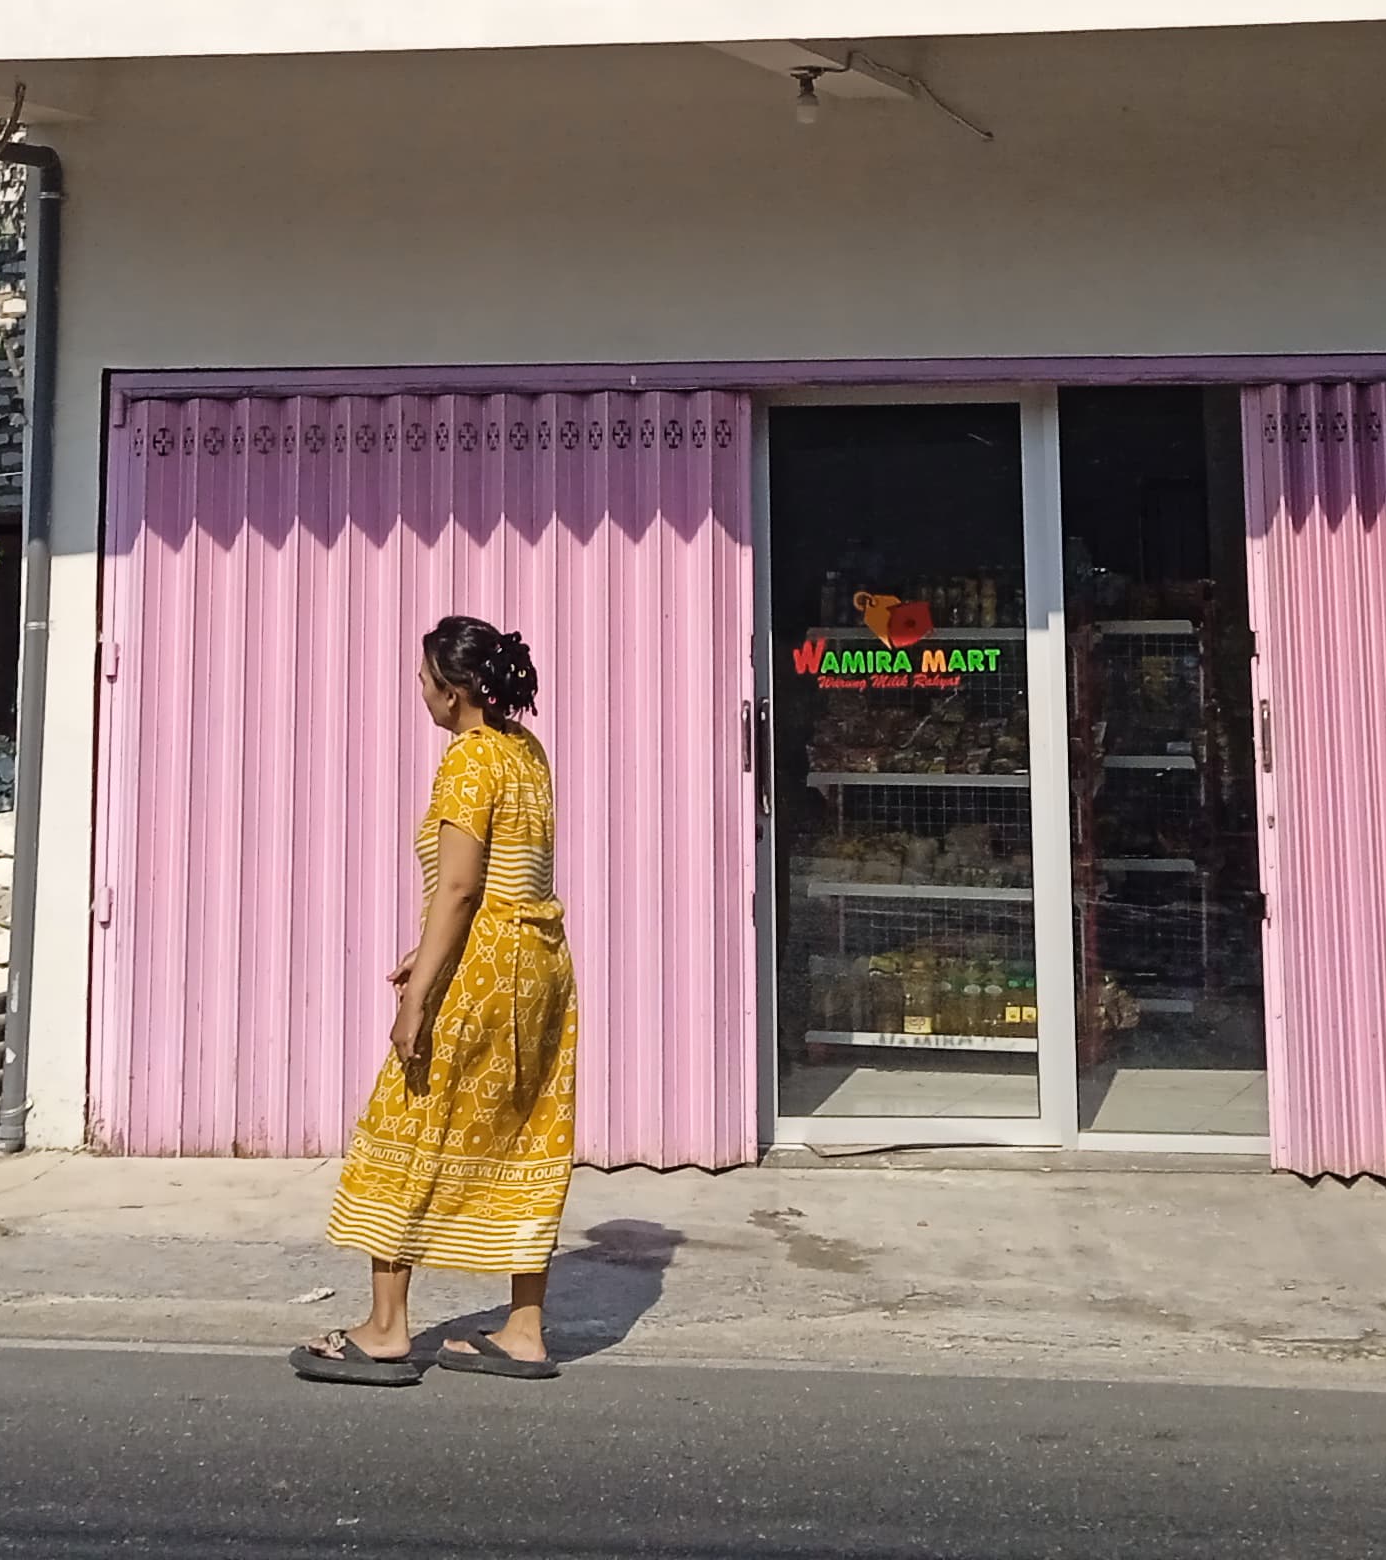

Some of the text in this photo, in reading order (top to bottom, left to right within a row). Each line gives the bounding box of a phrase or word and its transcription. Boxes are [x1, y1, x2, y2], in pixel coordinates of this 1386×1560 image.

[793, 636, 1001, 674] WAMIRA MART
[817, 674, 961, 691] Warung Milik Rakyat
